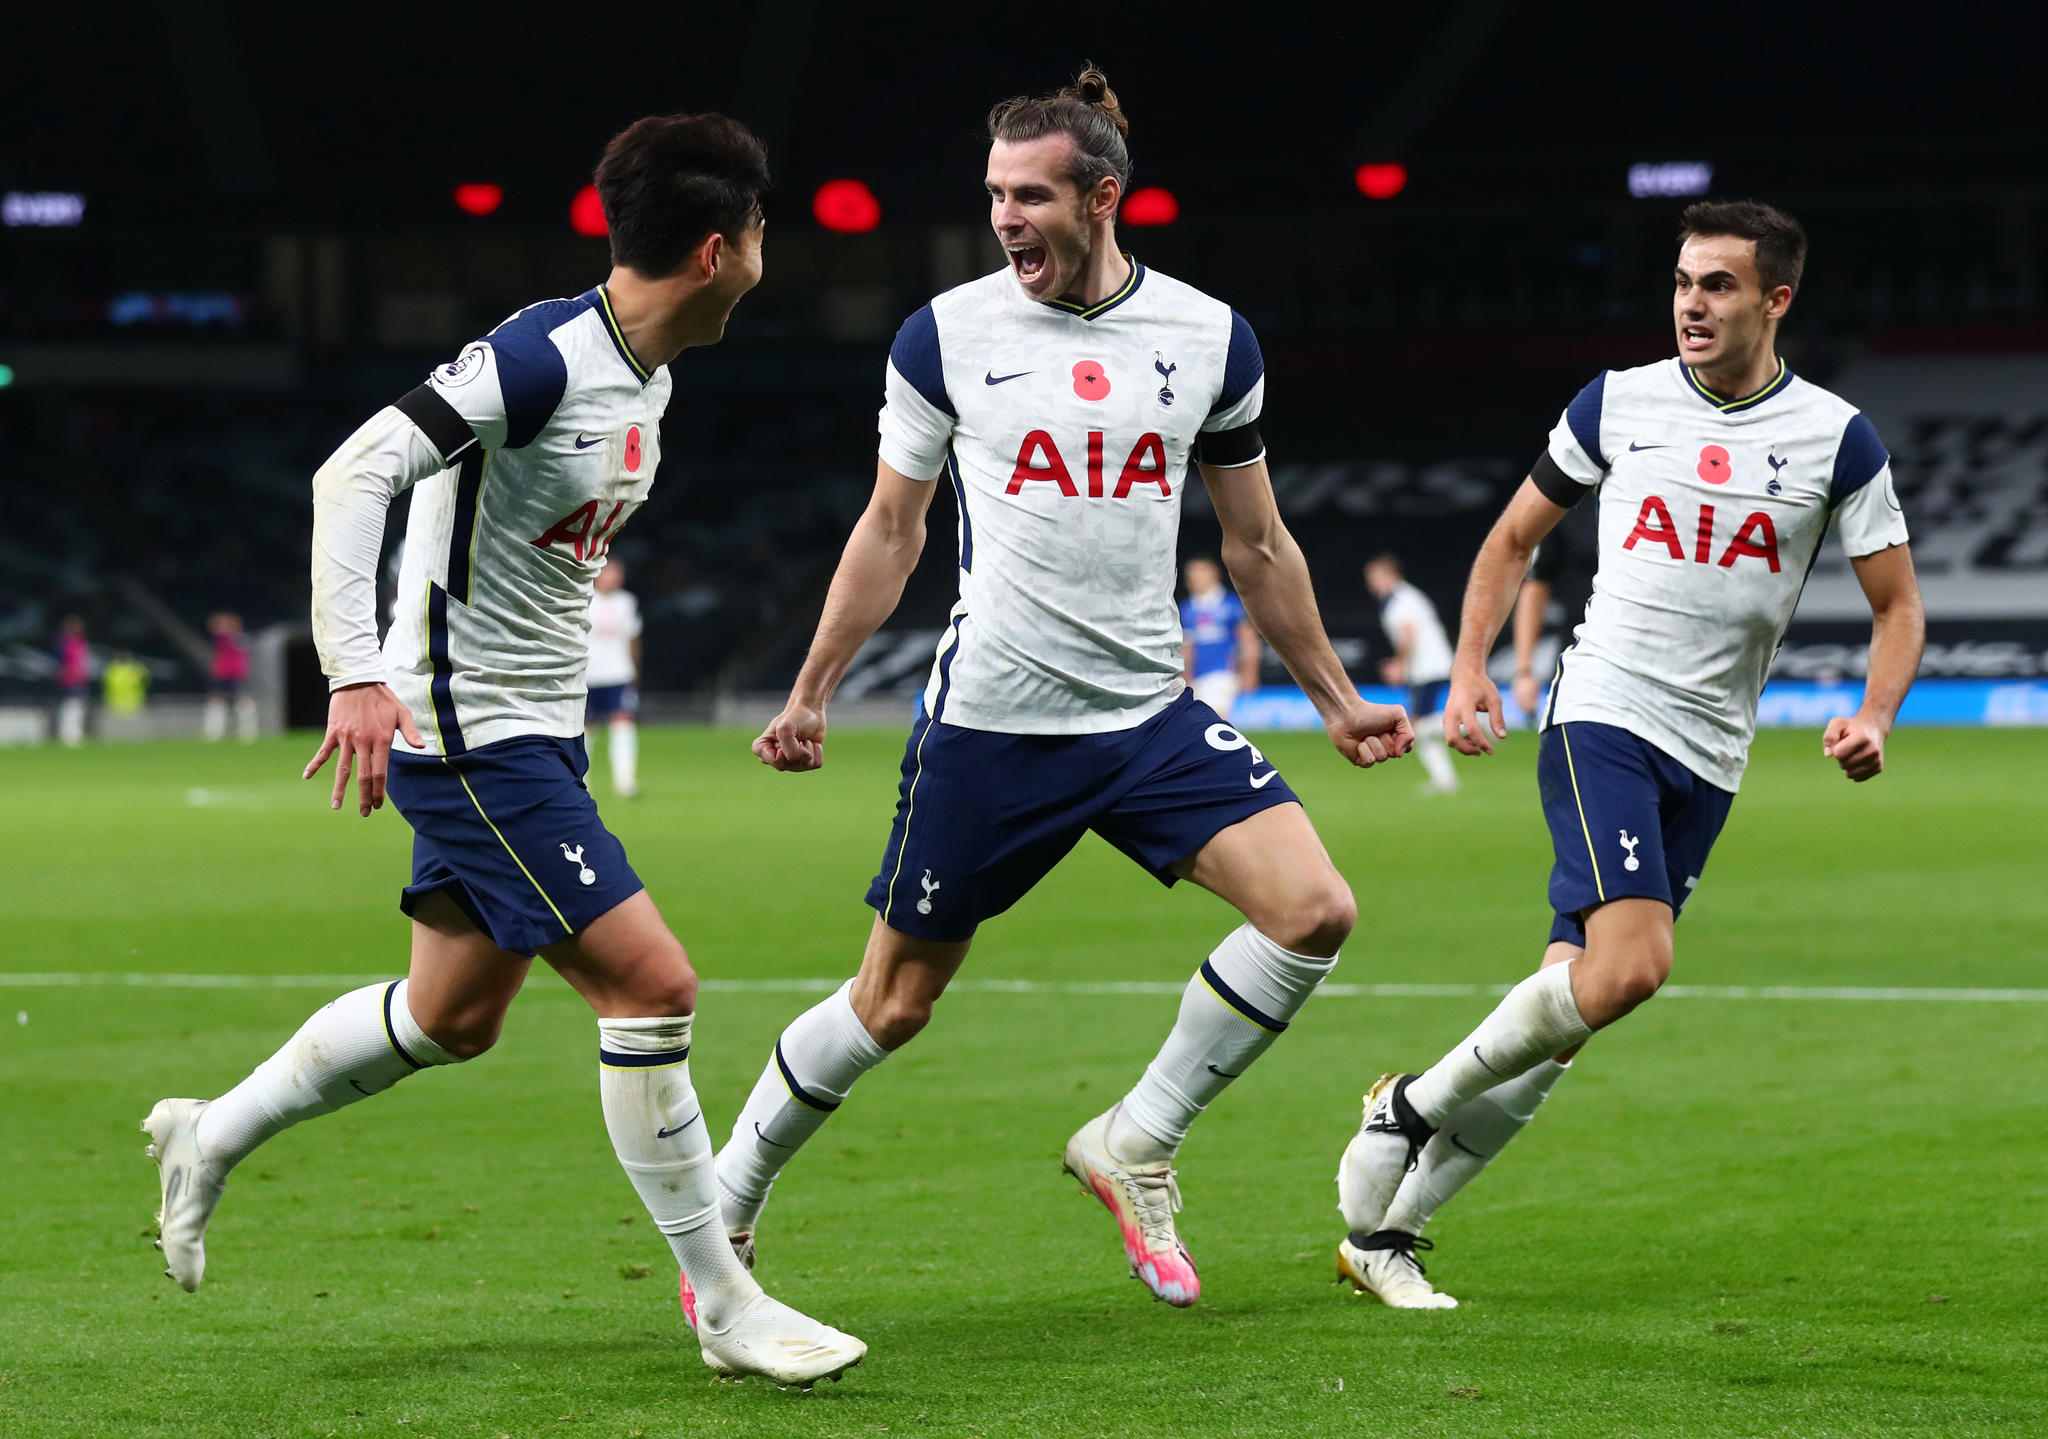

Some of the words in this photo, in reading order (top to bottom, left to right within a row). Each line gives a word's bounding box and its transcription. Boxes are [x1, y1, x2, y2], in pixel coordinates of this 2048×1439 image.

[1005, 430, 1172, 498] AIA
[529, 500, 624, 561] AI
[1622, 495, 1781, 573] AIA
[1204, 723, 1264, 765] 9
